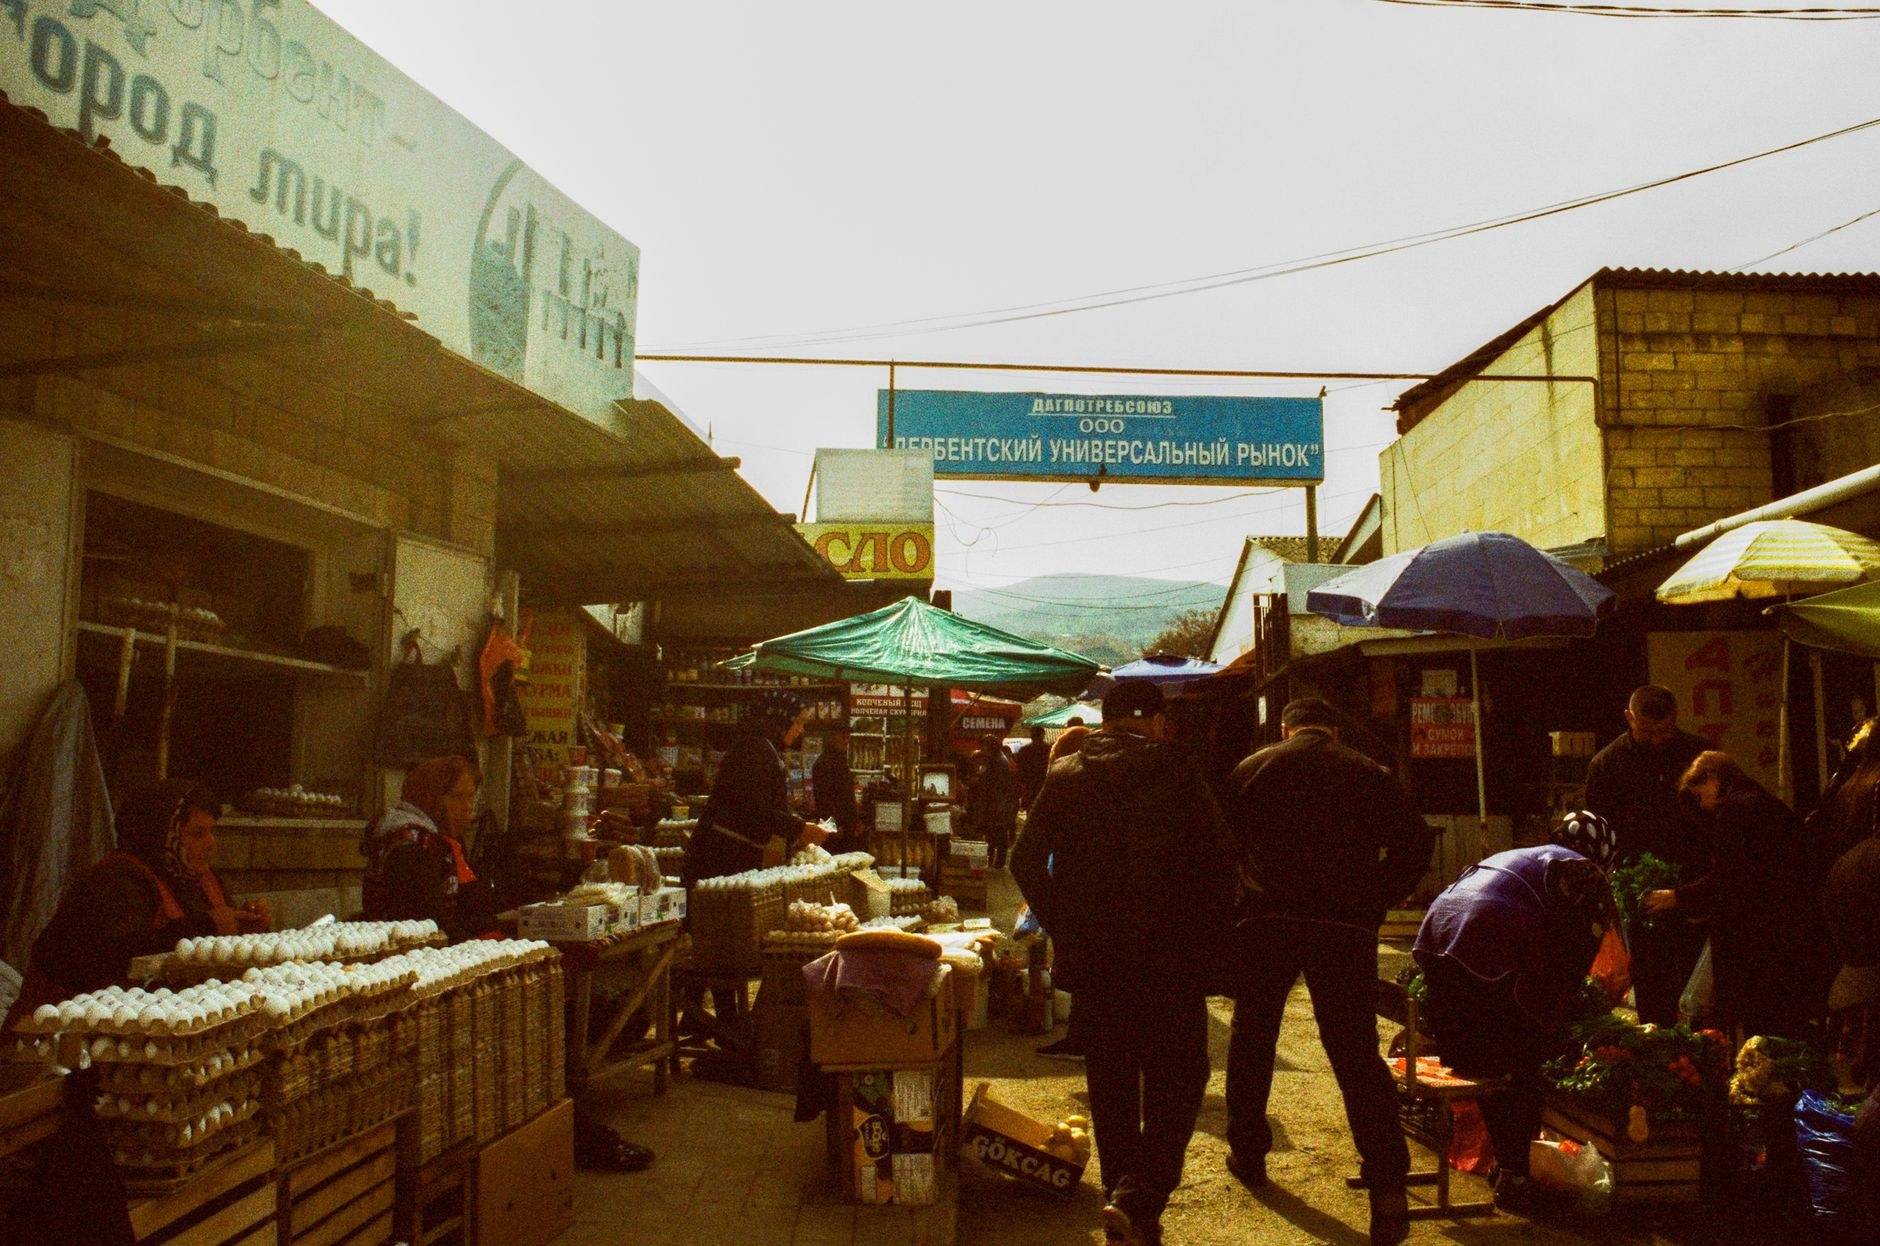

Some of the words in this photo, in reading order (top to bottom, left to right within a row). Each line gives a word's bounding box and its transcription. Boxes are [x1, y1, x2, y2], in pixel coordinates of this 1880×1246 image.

[1032, 398, 1173, 415] ДАГПОТРЕБСОЮЗ
[1079, 418, 1125, 434] ООО
[1049, 436, 1230, 467] УНИВЕРСАЛЬНЫЙ
[801, 531, 931, 574] СЛО
[962, 717, 1006, 730] СЕМЕНА
